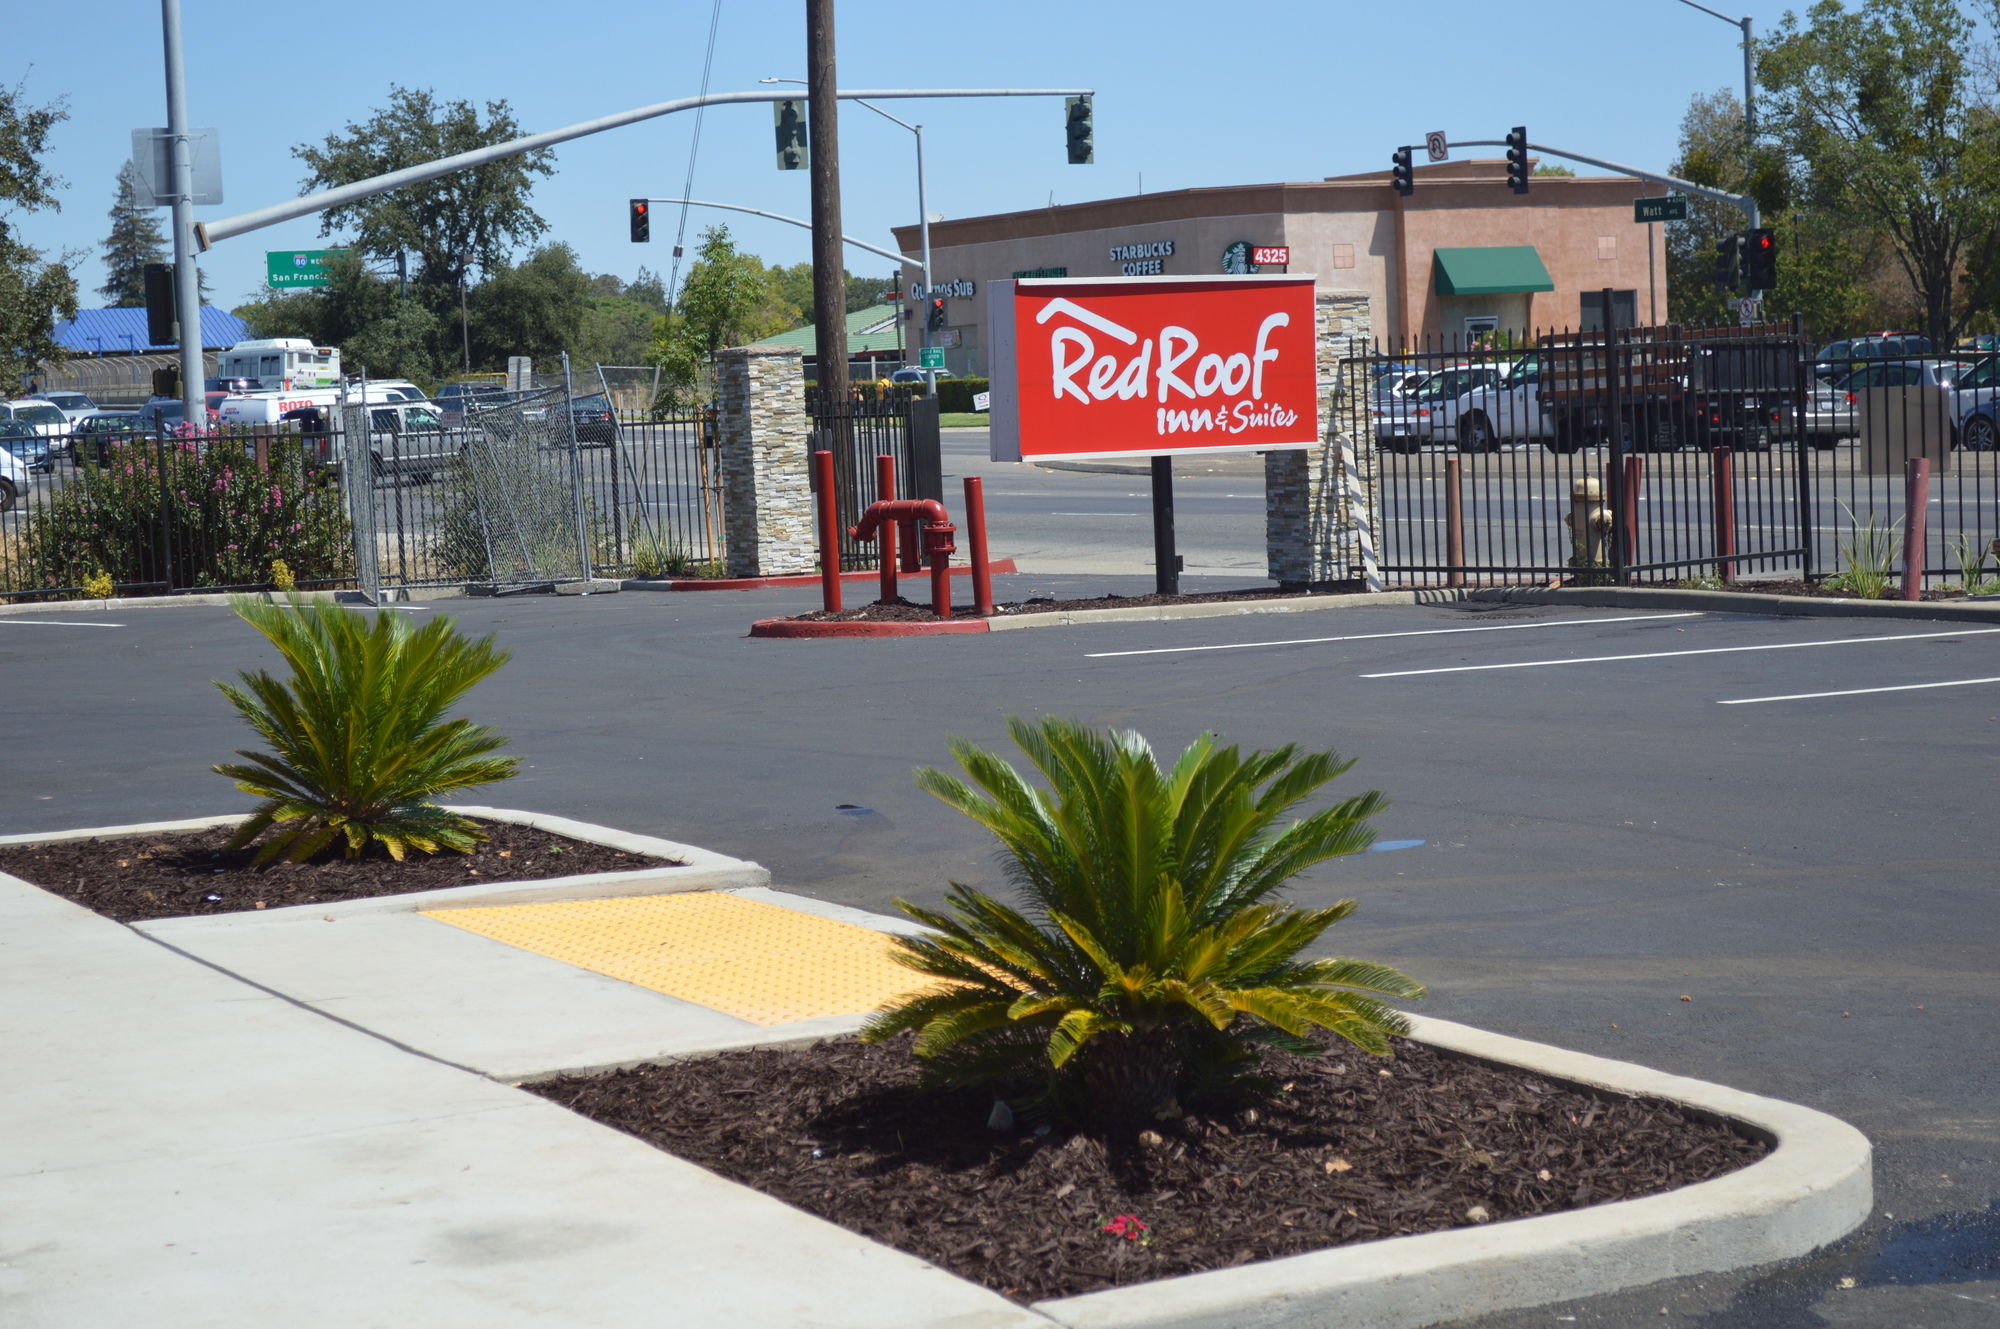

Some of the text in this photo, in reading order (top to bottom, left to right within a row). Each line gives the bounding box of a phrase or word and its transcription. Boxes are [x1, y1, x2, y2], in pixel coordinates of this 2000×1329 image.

[1642, 206, 1662, 217] Watt
[1109, 241, 1173, 262] STARBUCKS
[1254, 248, 1287, 264] 4325
[295, 258, 306, 266] 80
[1122, 259, 1161, 276] COFFEE
[272, 273, 290, 281] San
[1051, 312, 1290, 405] Red Roof
[279, 400, 313, 412] ROTO
[1214, 405, 1229, 432] &
[1229, 400, 1298, 434] Suites
